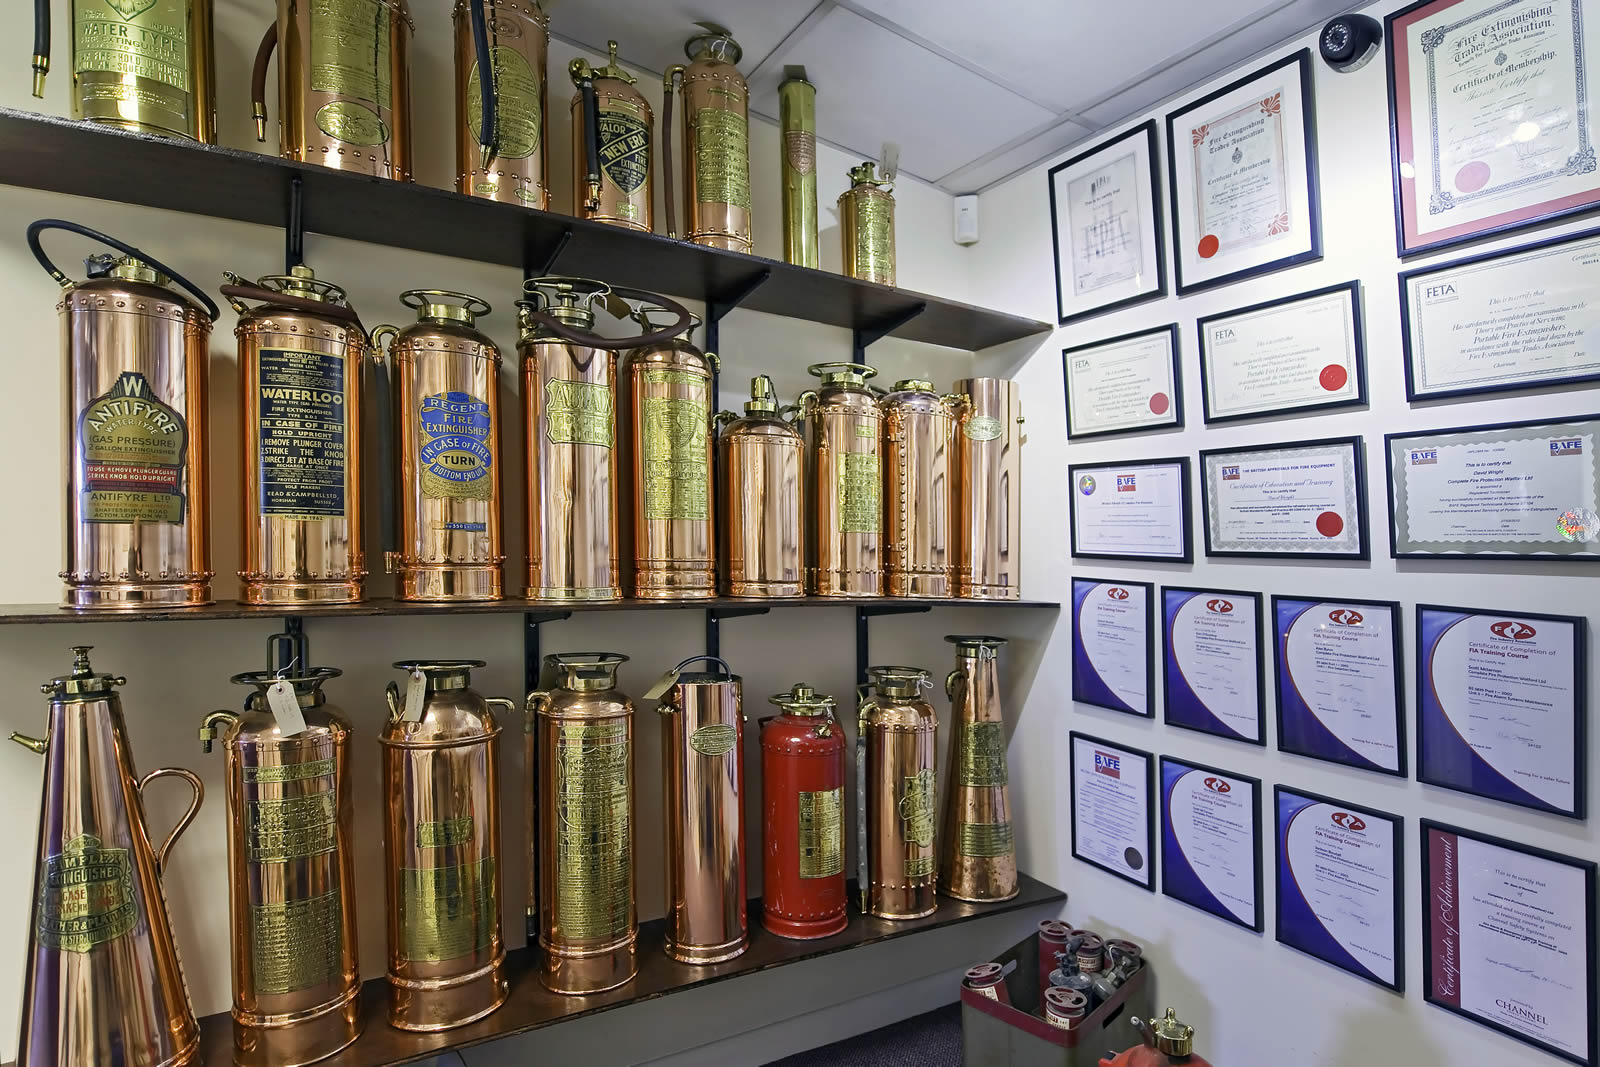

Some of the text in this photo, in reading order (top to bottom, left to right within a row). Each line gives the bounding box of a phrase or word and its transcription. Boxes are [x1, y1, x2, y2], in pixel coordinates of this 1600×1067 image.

[1454, 6, 1553, 51] Fire Extinguishing
[83, 23, 179, 51] WATER TYPE
[1454, 41, 1486, 62] Trades
[1452, 72, 1496, 93] Certificate
[1426, 284, 1455, 298] FETA
[1215, 329, 1235, 340] FETA
[1516, 324, 1566, 337] Extinguishers
[283, 352, 322, 361] IMPORTANT
[1075, 360, 1090, 369] FETA
[122, 375, 143, 397] W
[261, 388, 343, 405] WATERLOO
[286, 407, 333, 416] EXTINGUISHER
[430, 399, 483, 412] REGENT
[88, 401, 180, 436] ANTIFYRE
[444, 413, 473, 424] FIRE
[105, 418, 159, 435] WATER TYPE
[276, 420, 301, 428] CASE
[323, 423, 343, 431] FIRE
[426, 422, 488, 437] EXTINGUISHER
[298, 430, 333, 439] UPRIGHT
[264, 438, 343, 450] REMOVE PLUNGER COVER
[422, 446, 435, 459] IN
[434, 438, 460, 451] CASE
[472, 442, 490, 461] FIRE
[1549, 440, 1582, 452] BAFE
[264, 447, 344, 459] STRIKE THE KNOB
[1411, 451, 1438, 461] BAFE
[264, 456, 344, 467] DIRECT JET AT BASE OF FIRE
[443, 455, 476, 466] TURN
[433, 465, 461, 480] BOTTOM
[1222, 468, 1240, 476] BAFE
[1117, 477, 1136, 486] BAFE
[91, 493, 148, 502] ANTIFYRE
[1468, 642, 1500, 650] Certificate
[1510, 646, 1547, 655] Completion
[1480, 649, 1506, 657] Training
[1507, 652, 1529, 660] Course
[1094, 754, 1121, 771] BAFE
[1437, 836, 1455, 921] Achievement
[1438, 934, 1460, 997] Certificate
[1495, 999, 1547, 1025] CHANNEL
